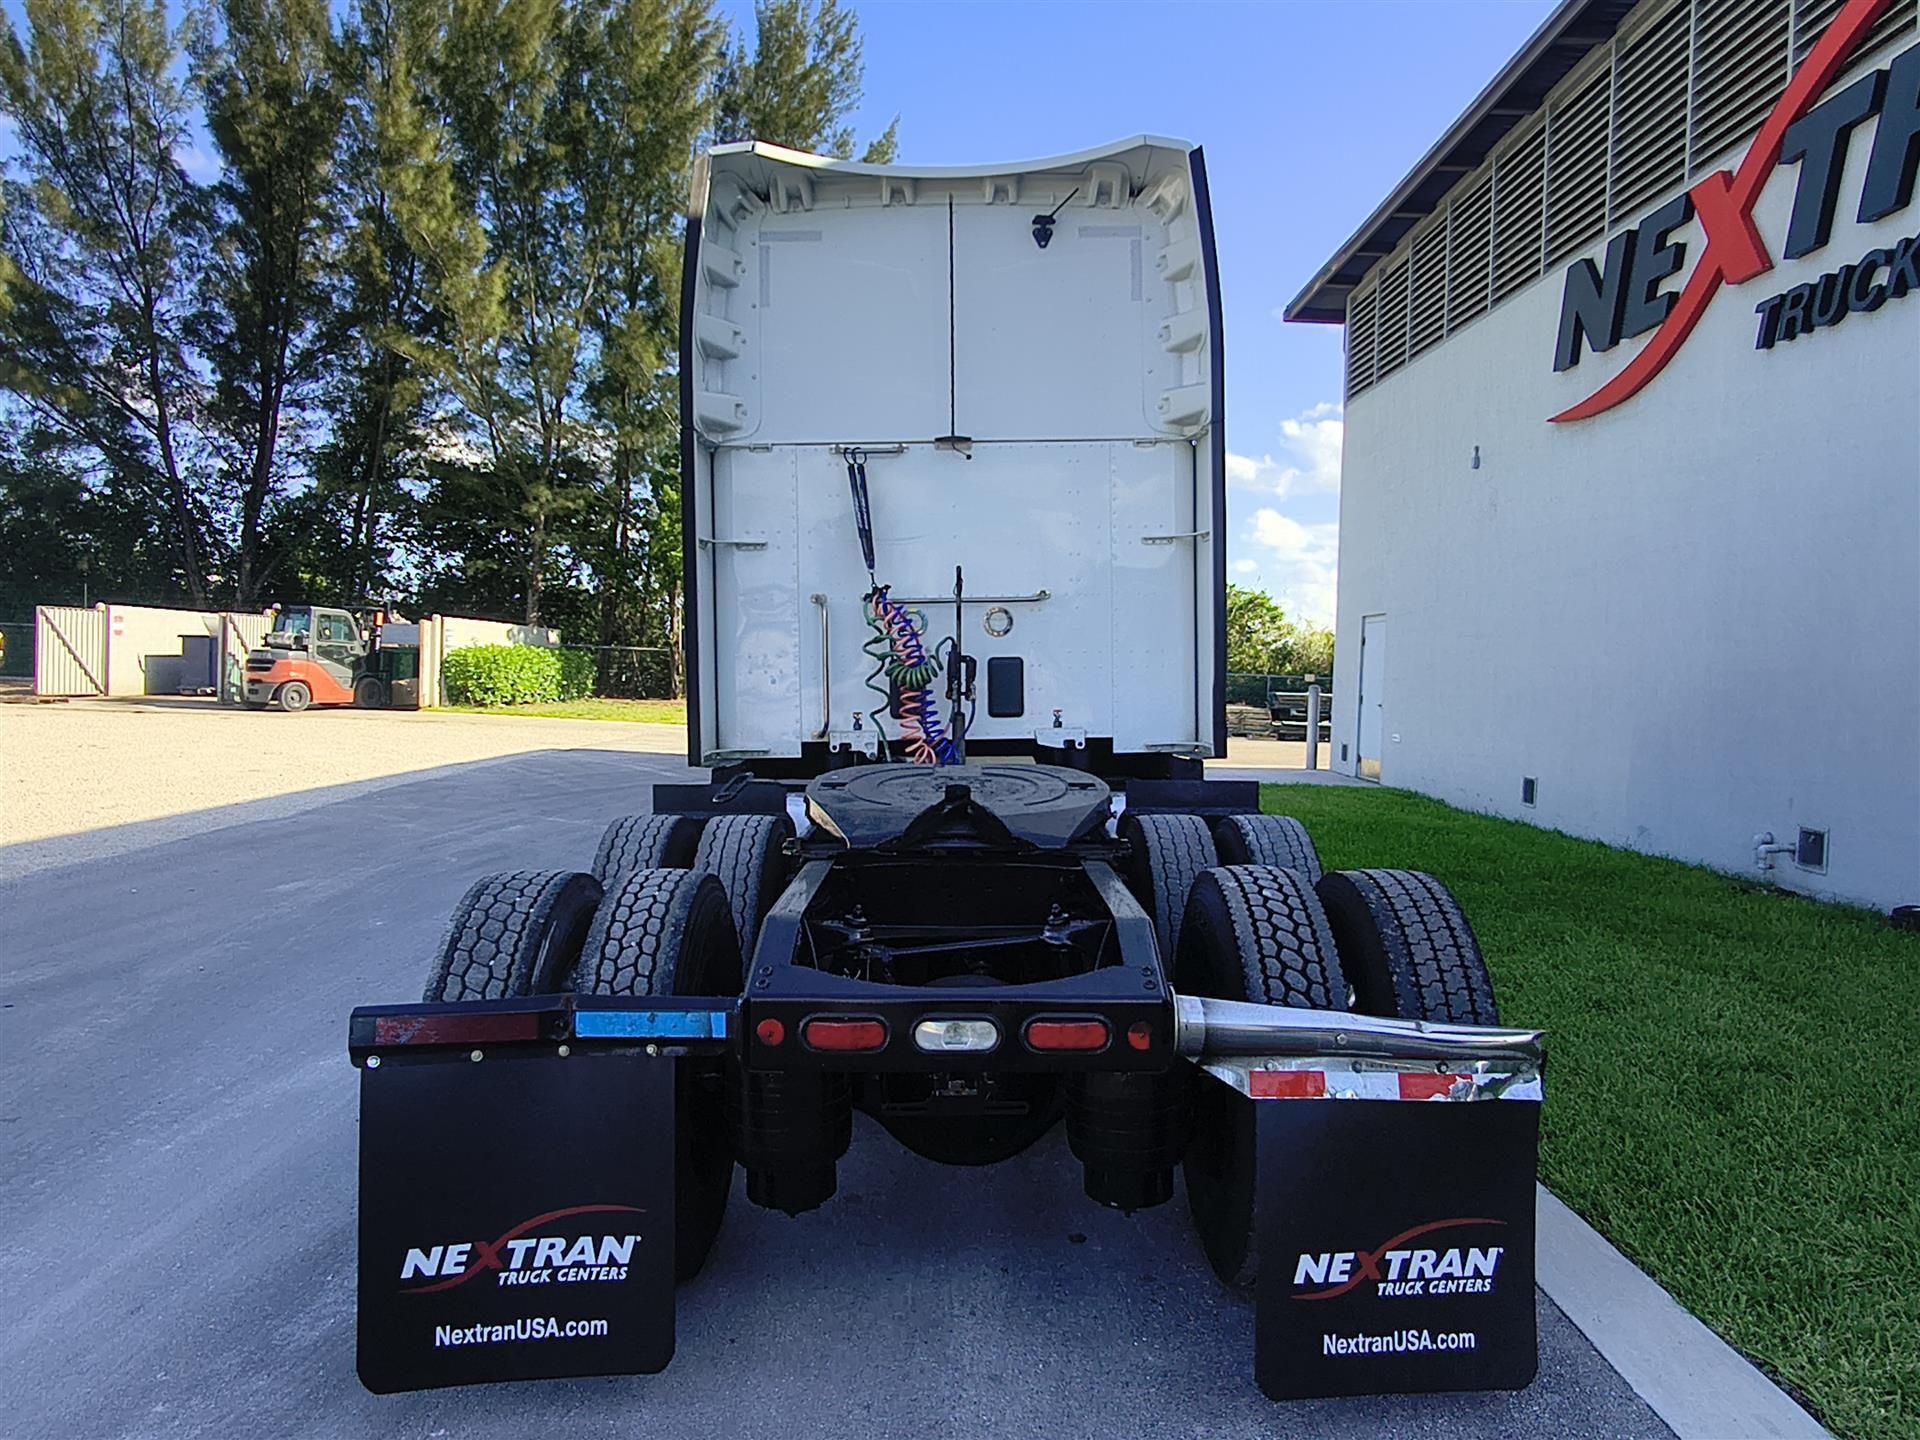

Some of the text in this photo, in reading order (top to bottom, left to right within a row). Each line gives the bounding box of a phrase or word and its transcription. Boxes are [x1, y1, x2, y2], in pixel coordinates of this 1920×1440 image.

[400, 1235, 637, 1279] NEXTRAN
[1293, 1247, 1500, 1285] NEXTRAN
[498, 1266, 628, 1286] TRUCK CENTERS
[1377, 1279, 1492, 1296] TRUCK CENTERS
[434, 1317, 608, 1347] NextranUSA.com
[1323, 1329, 1475, 1355] NextranUSA.com
